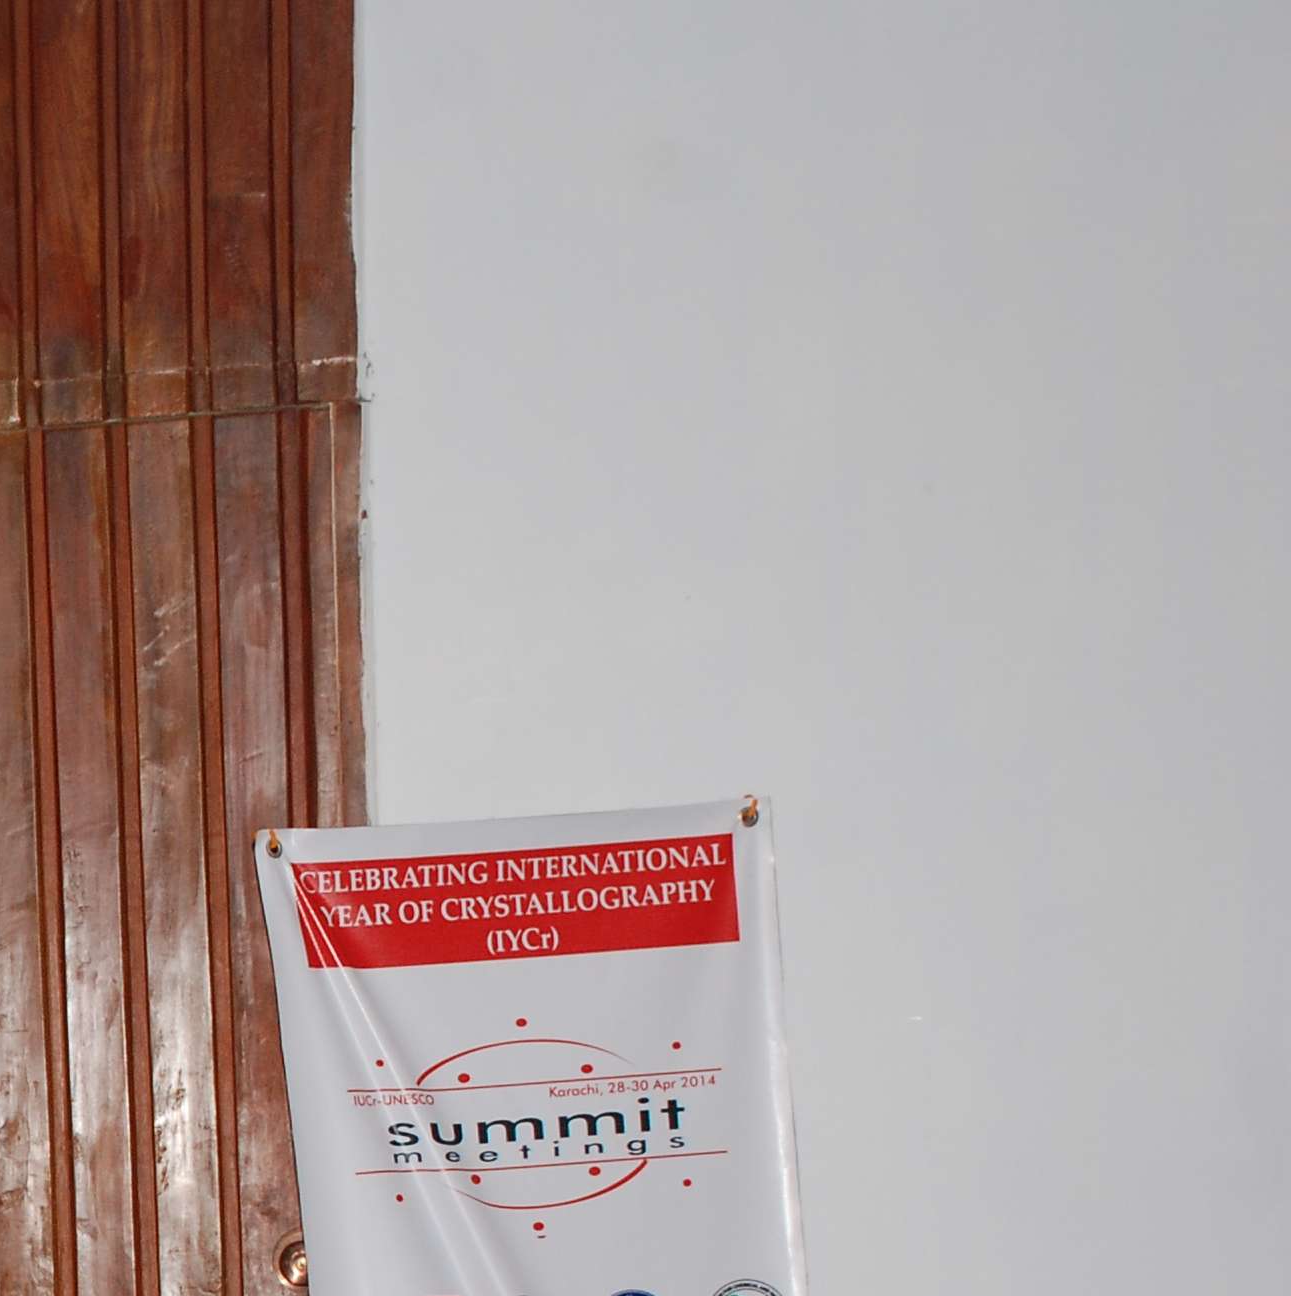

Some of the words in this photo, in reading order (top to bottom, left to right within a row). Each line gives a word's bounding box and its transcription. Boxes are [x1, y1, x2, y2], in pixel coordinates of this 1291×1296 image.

[299, 860, 488, 894] CELEBRATING
[495, 843, 726, 882] INTERNATIONAL
[320, 903, 394, 928] YEAR
[398, 900, 434, 924] OF
[441, 879, 715, 921] CRYSTALLOGRAPHY
[486, 926, 559, 955] (IYCr)
[549, 1084, 603, 1098] Karachi,
[607, 1079, 649, 1094] 28-30
[653, 1079, 677, 1093] Apr
[681, 1075, 716, 1087] 2014
[388, 1097, 686, 1147] summit
[393, 1136, 686, 1164] meetings
